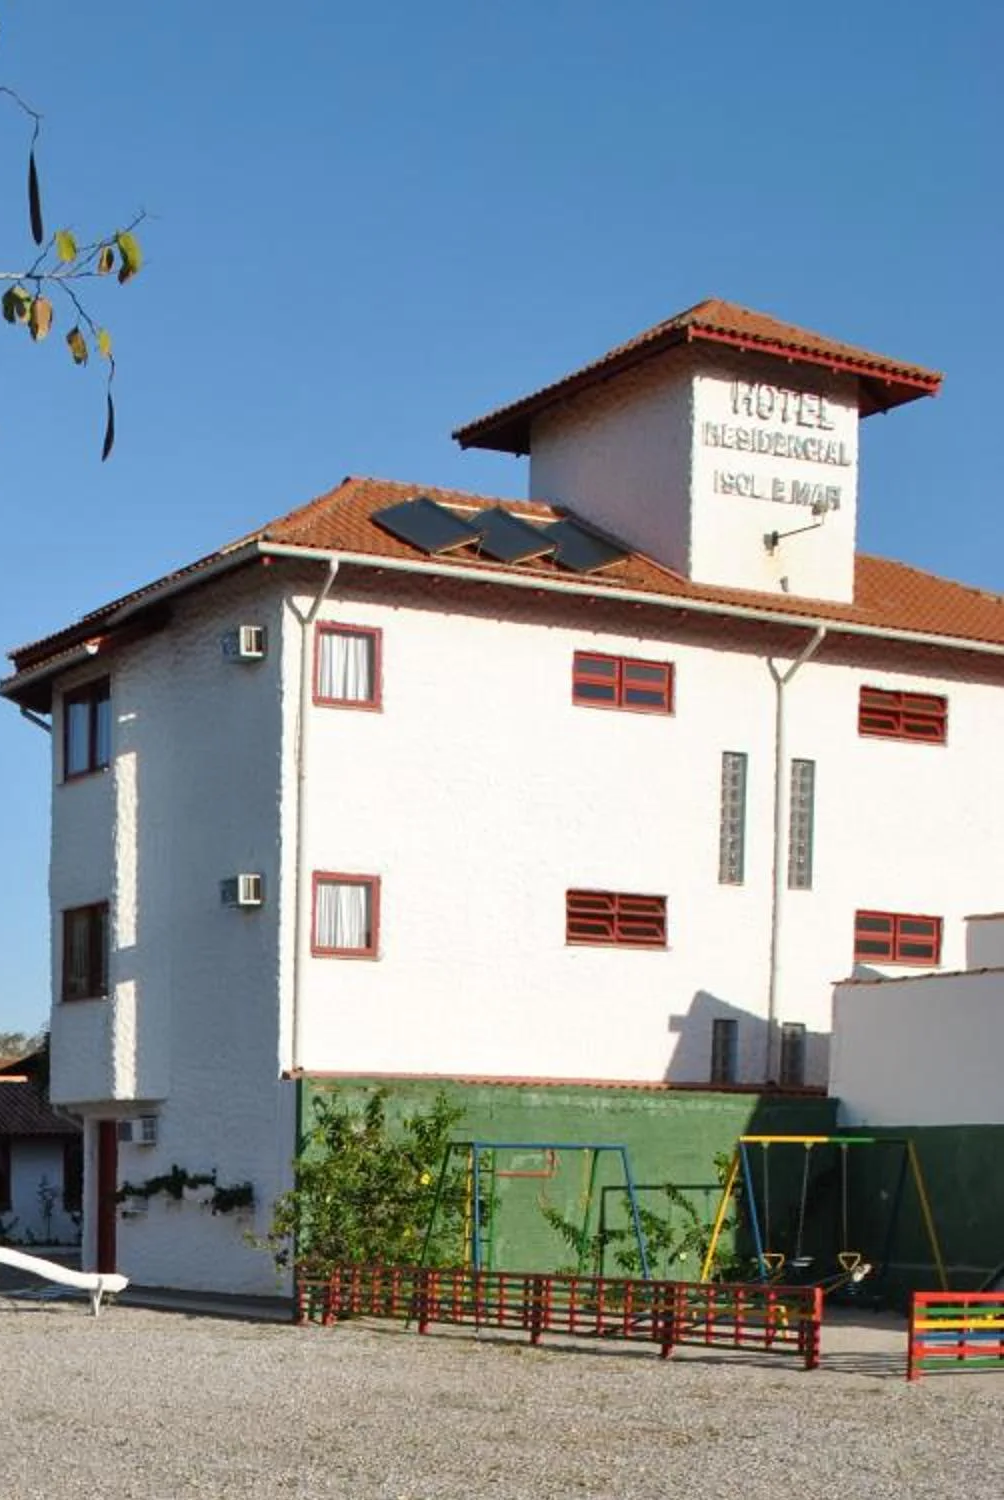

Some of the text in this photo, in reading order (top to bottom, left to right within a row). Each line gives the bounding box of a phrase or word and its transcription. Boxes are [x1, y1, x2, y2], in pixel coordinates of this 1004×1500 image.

[730, 379, 834, 431] HOTEL
[703, 420, 852, 467] RESIDENCIAL
[771, 476, 785, 502] E
[790, 479, 841, 511] MAR
